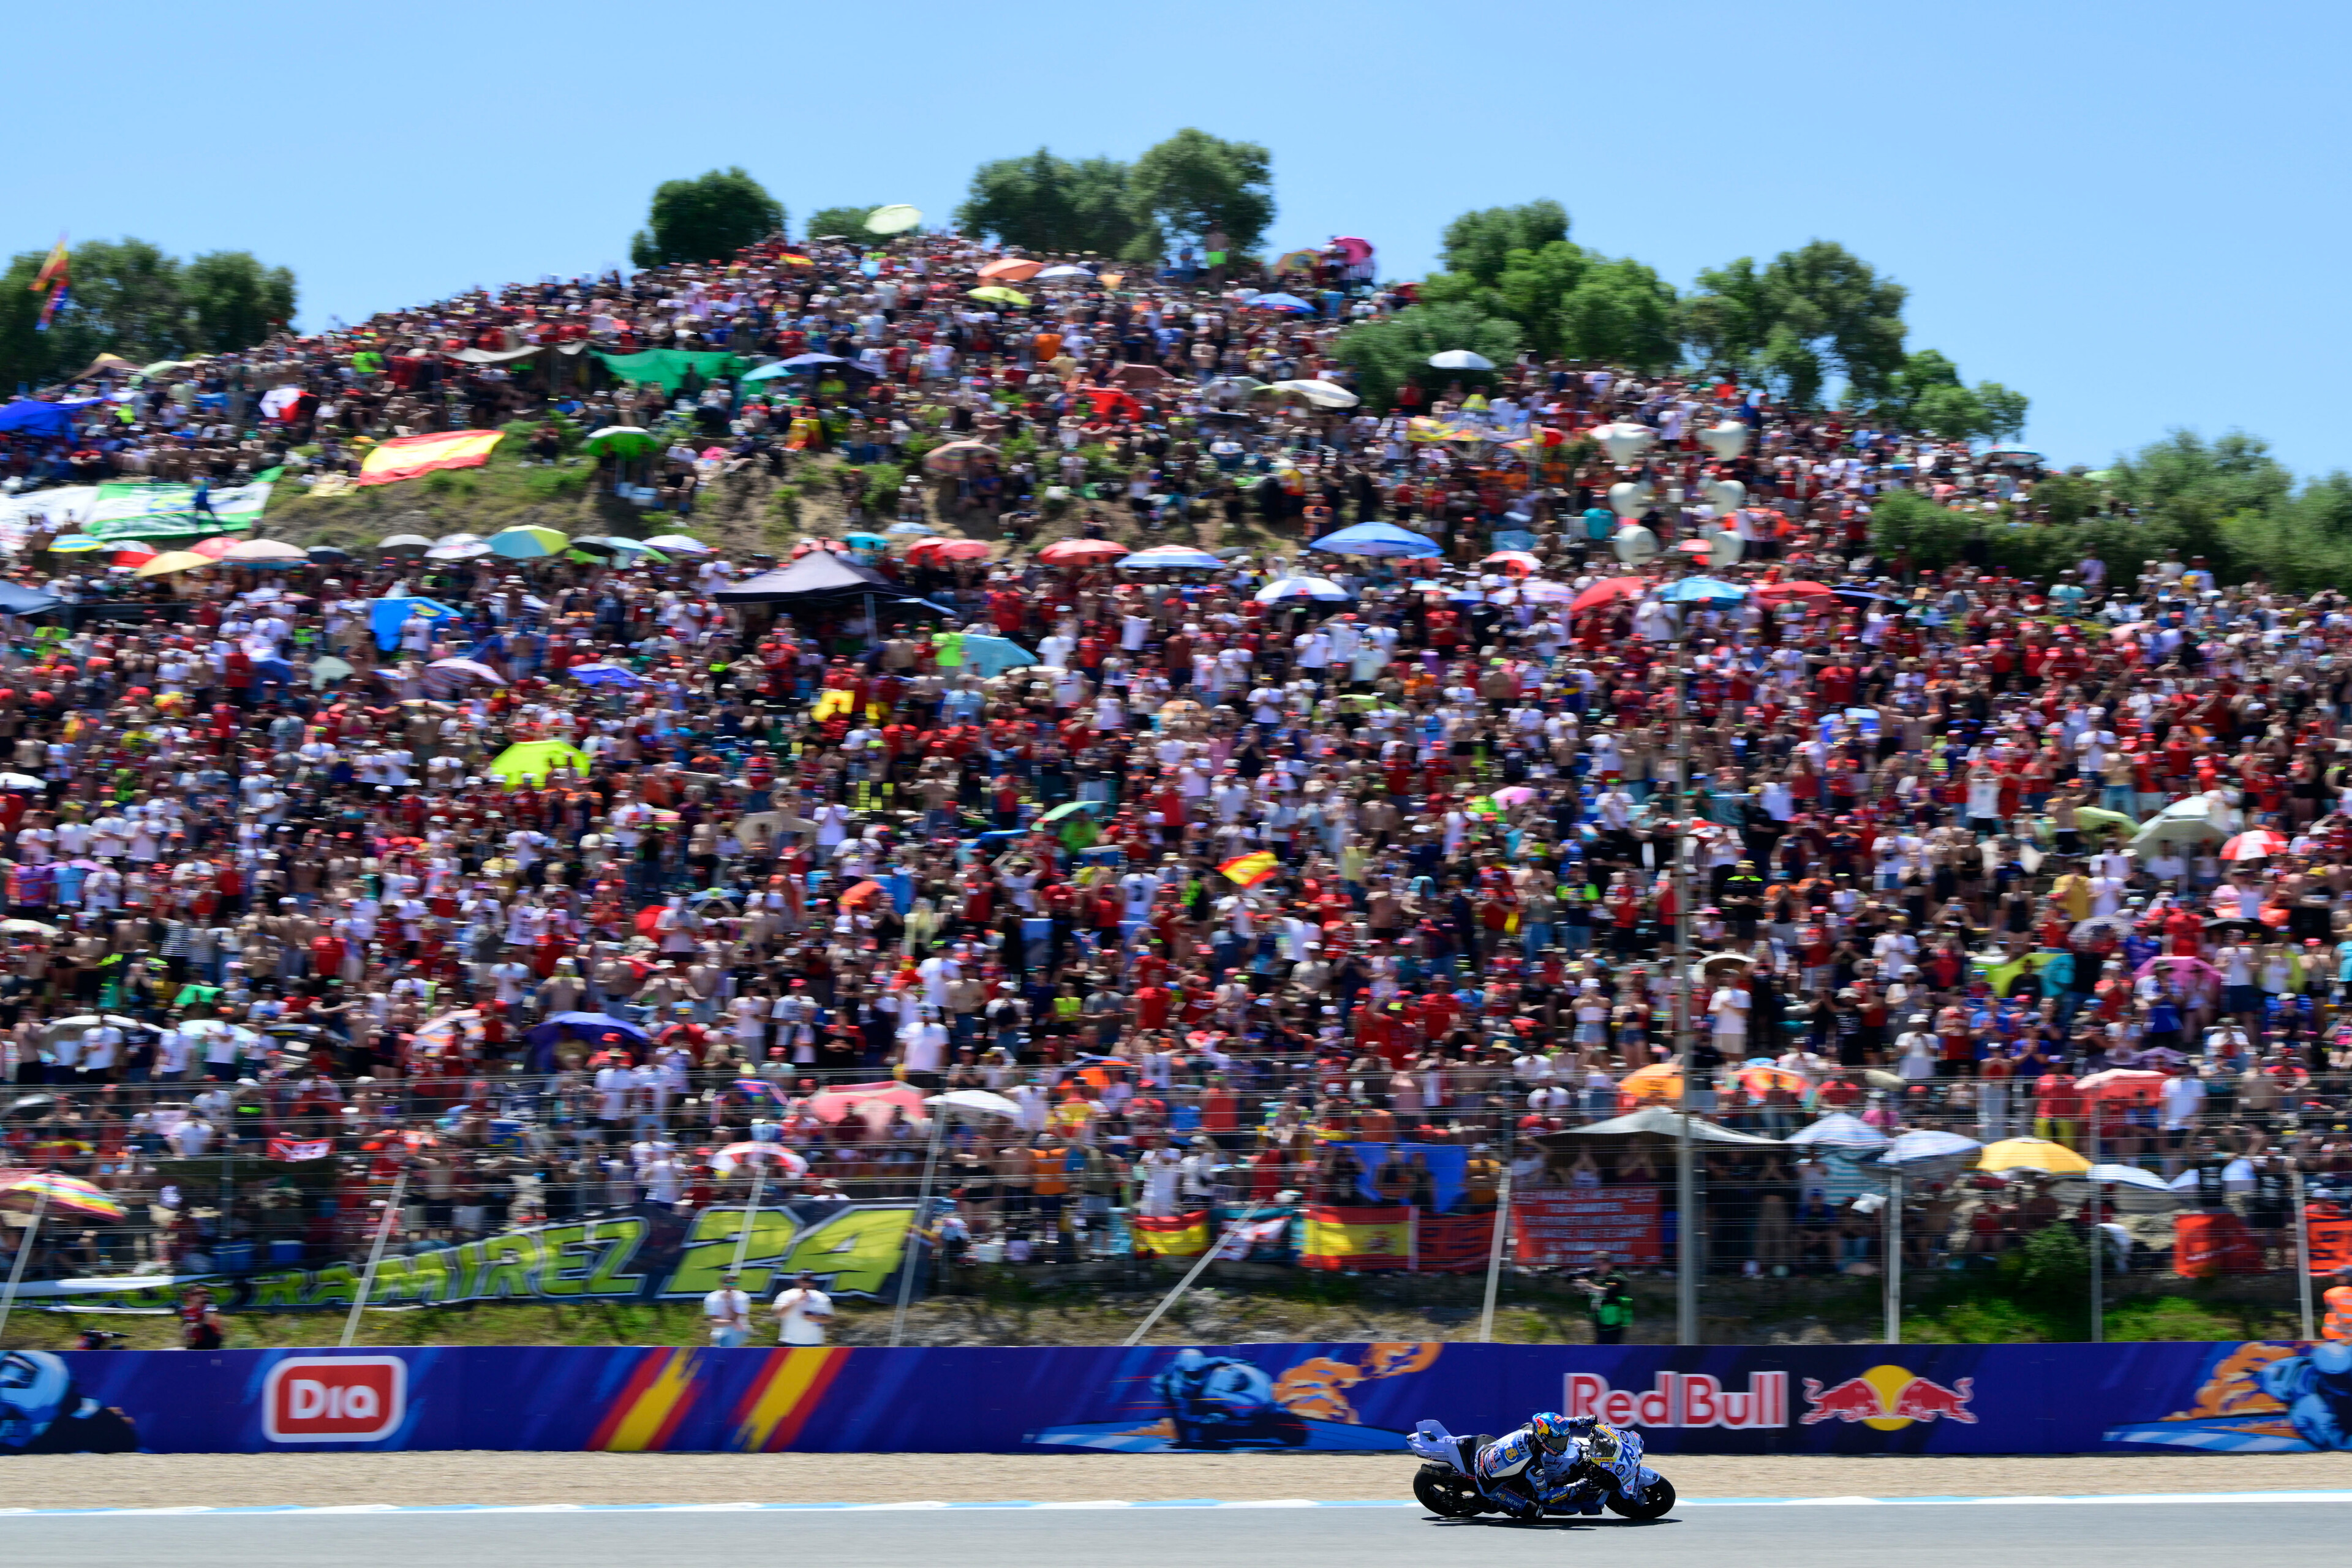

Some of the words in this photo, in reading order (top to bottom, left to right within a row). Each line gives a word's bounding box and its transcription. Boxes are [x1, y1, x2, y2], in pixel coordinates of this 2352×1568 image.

[248, 1216, 648, 1305] RAMIREZ
[655, 1205, 920, 1299] 24
[288, 1379, 380, 1419] Dia
[1495, 1491, 1506, 1501] K8
[1506, 1497, 1523, 1509] NEWS
